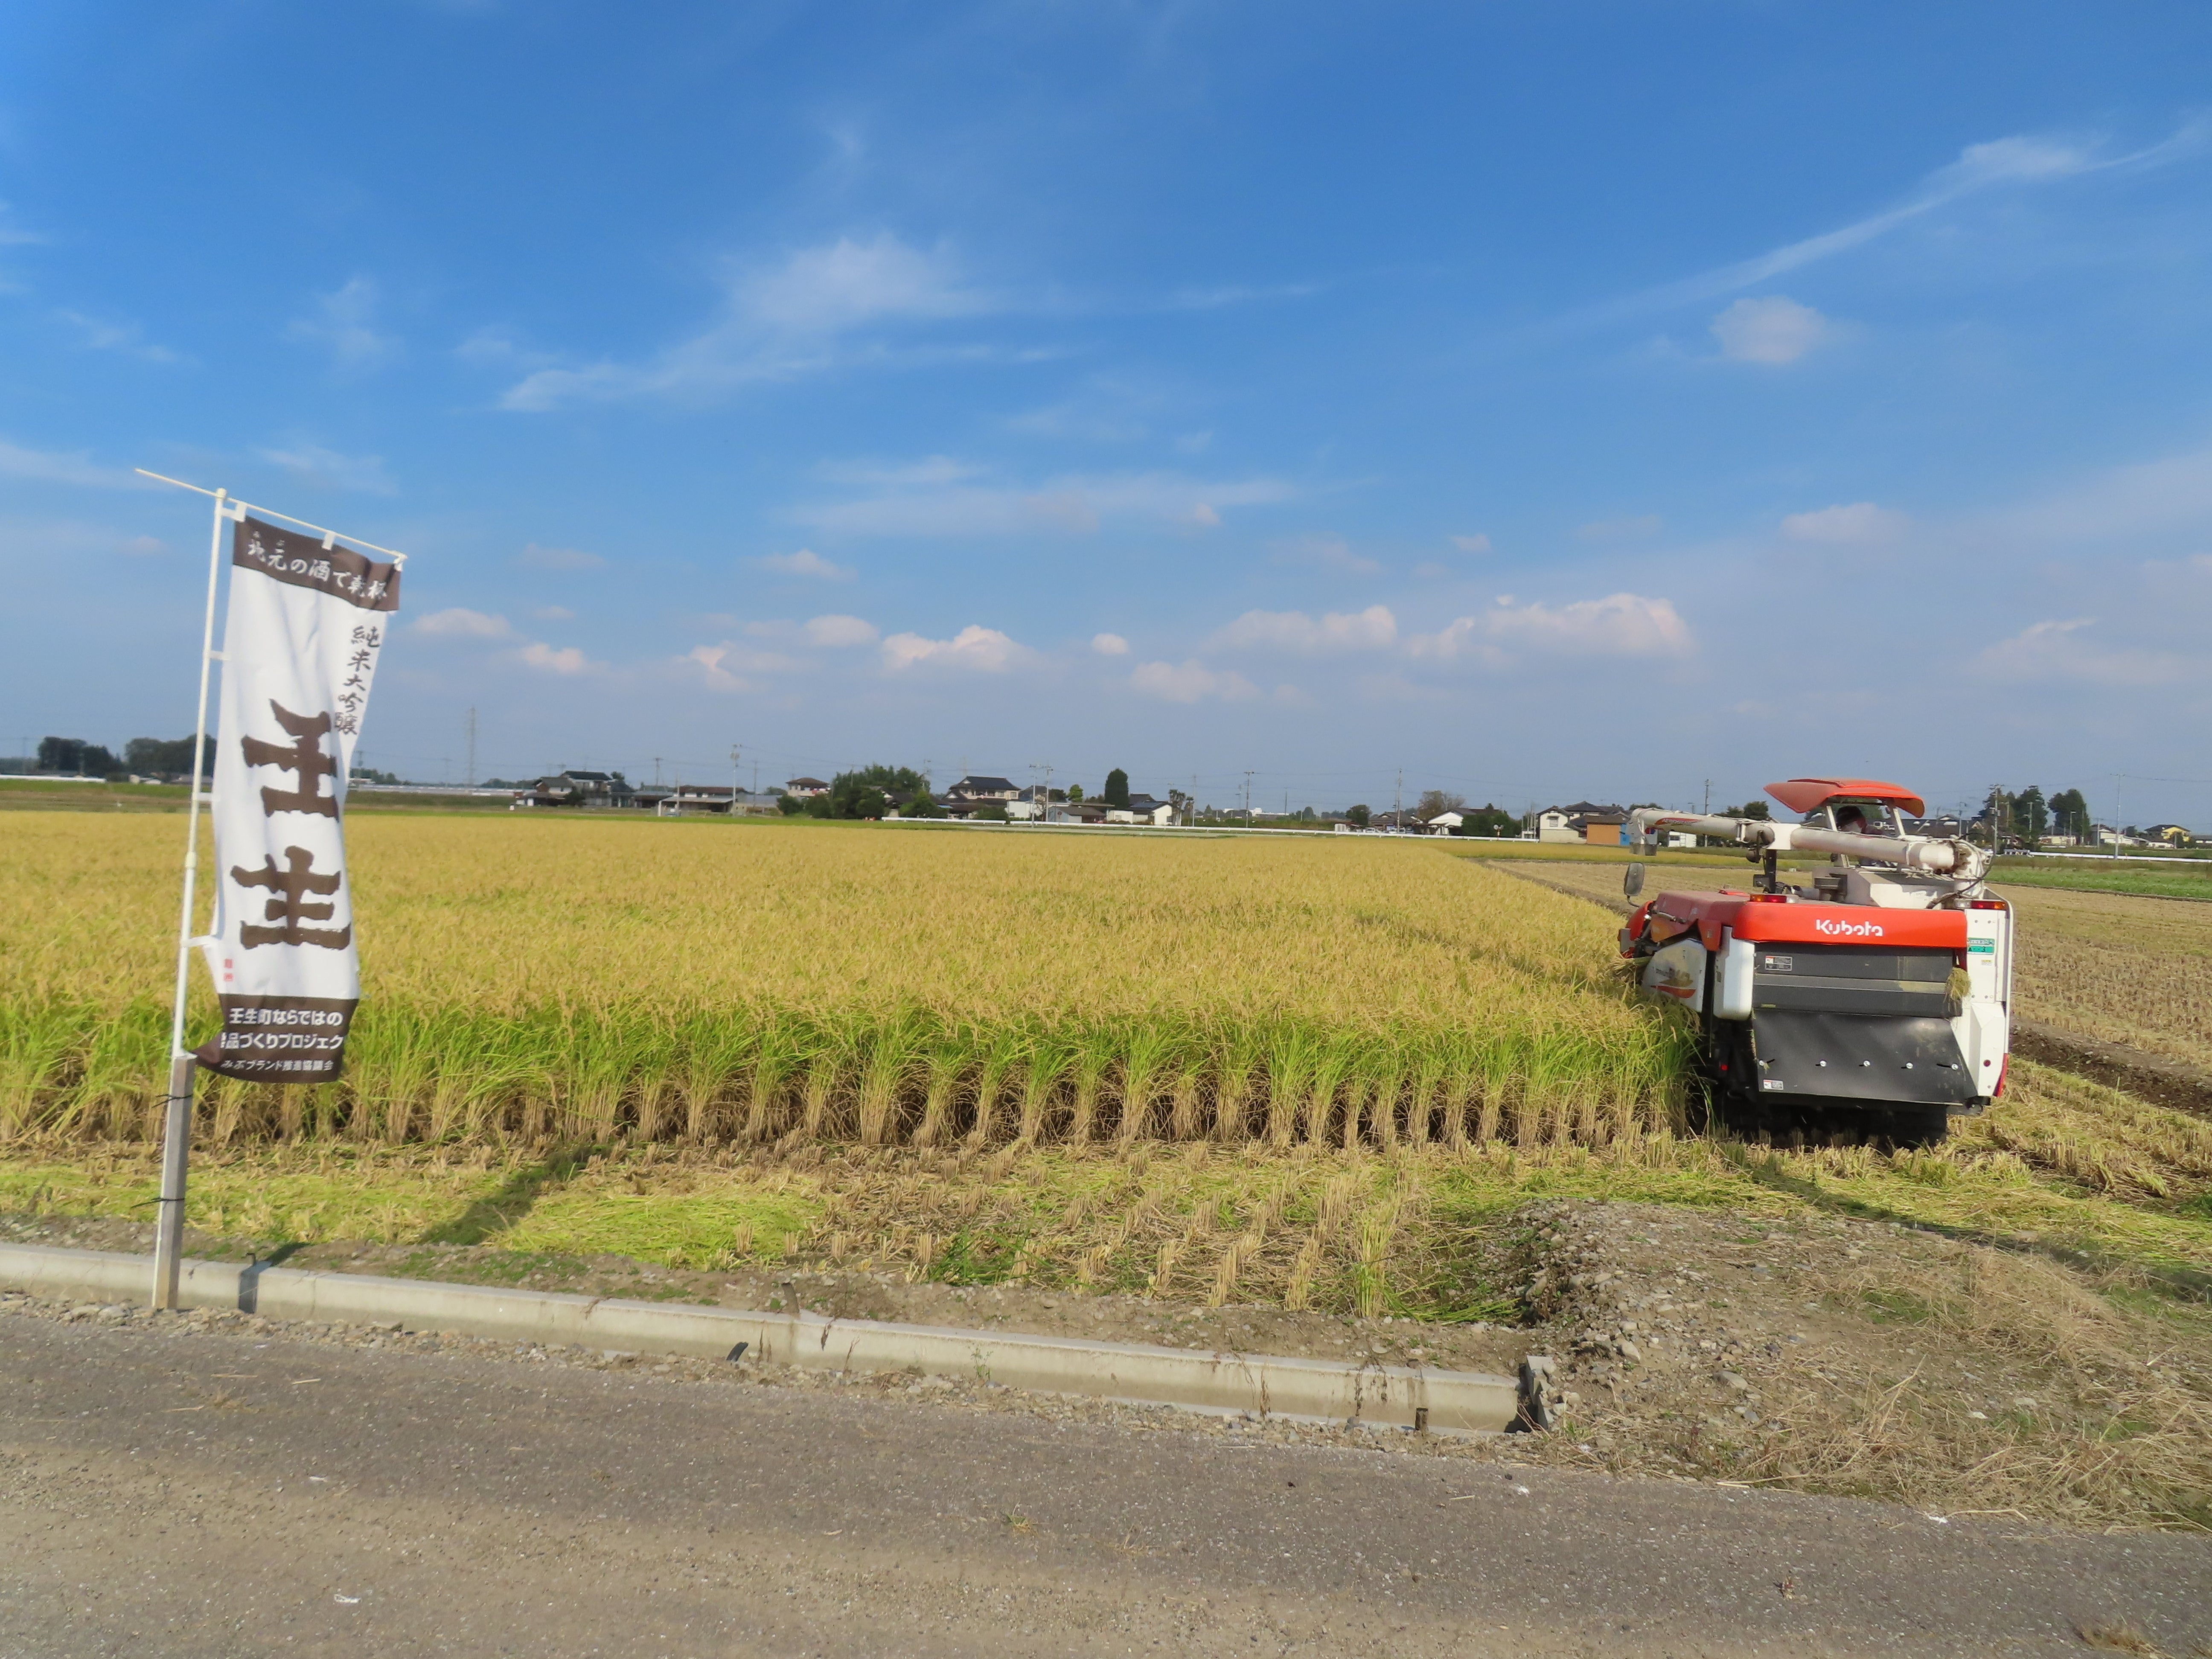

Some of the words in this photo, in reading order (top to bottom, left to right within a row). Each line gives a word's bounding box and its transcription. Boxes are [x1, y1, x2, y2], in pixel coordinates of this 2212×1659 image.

[335, 625, 381, 735] 純米大吟醸
[1816, 919, 1883, 937] Kubota
[229, 1007, 343, 1026] 壬生町ならではの
